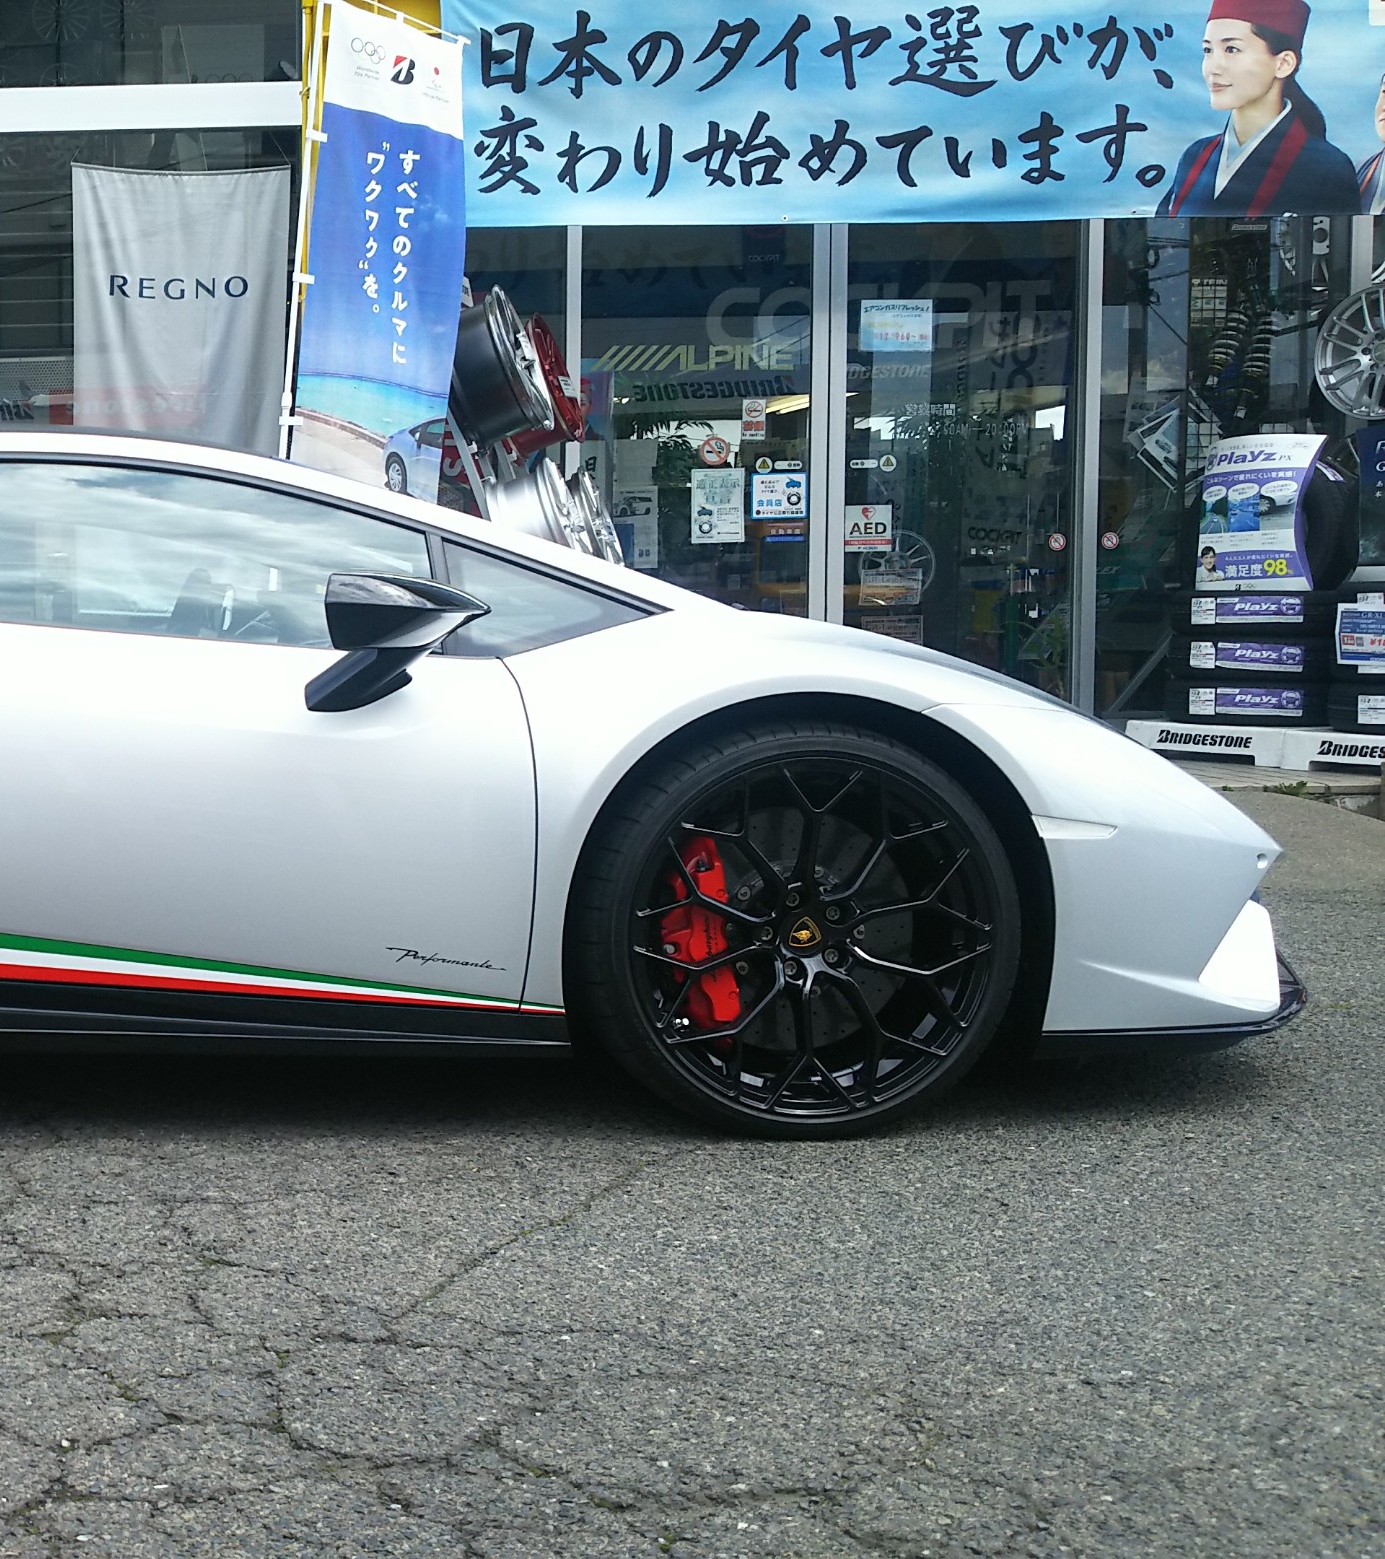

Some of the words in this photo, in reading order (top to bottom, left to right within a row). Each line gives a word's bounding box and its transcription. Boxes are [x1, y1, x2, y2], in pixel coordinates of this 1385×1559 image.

[478, 4, 1176, 99] 日本のタイヤ選びが、
[472, 104, 1168, 198] 変わり始めています。
[391, 150, 421, 364] すべてのクルマに
[109, 274, 249, 300] REGNO
[849, 522, 887, 535] AED
[1233, 602, 1279, 611] Playz
[1234, 649, 1280, 659] Playz
[1234, 694, 1280, 704] Playz
[1156, 729, 1253, 749] BRIDGESTONE
[385, 947, 507, 971] Performante
